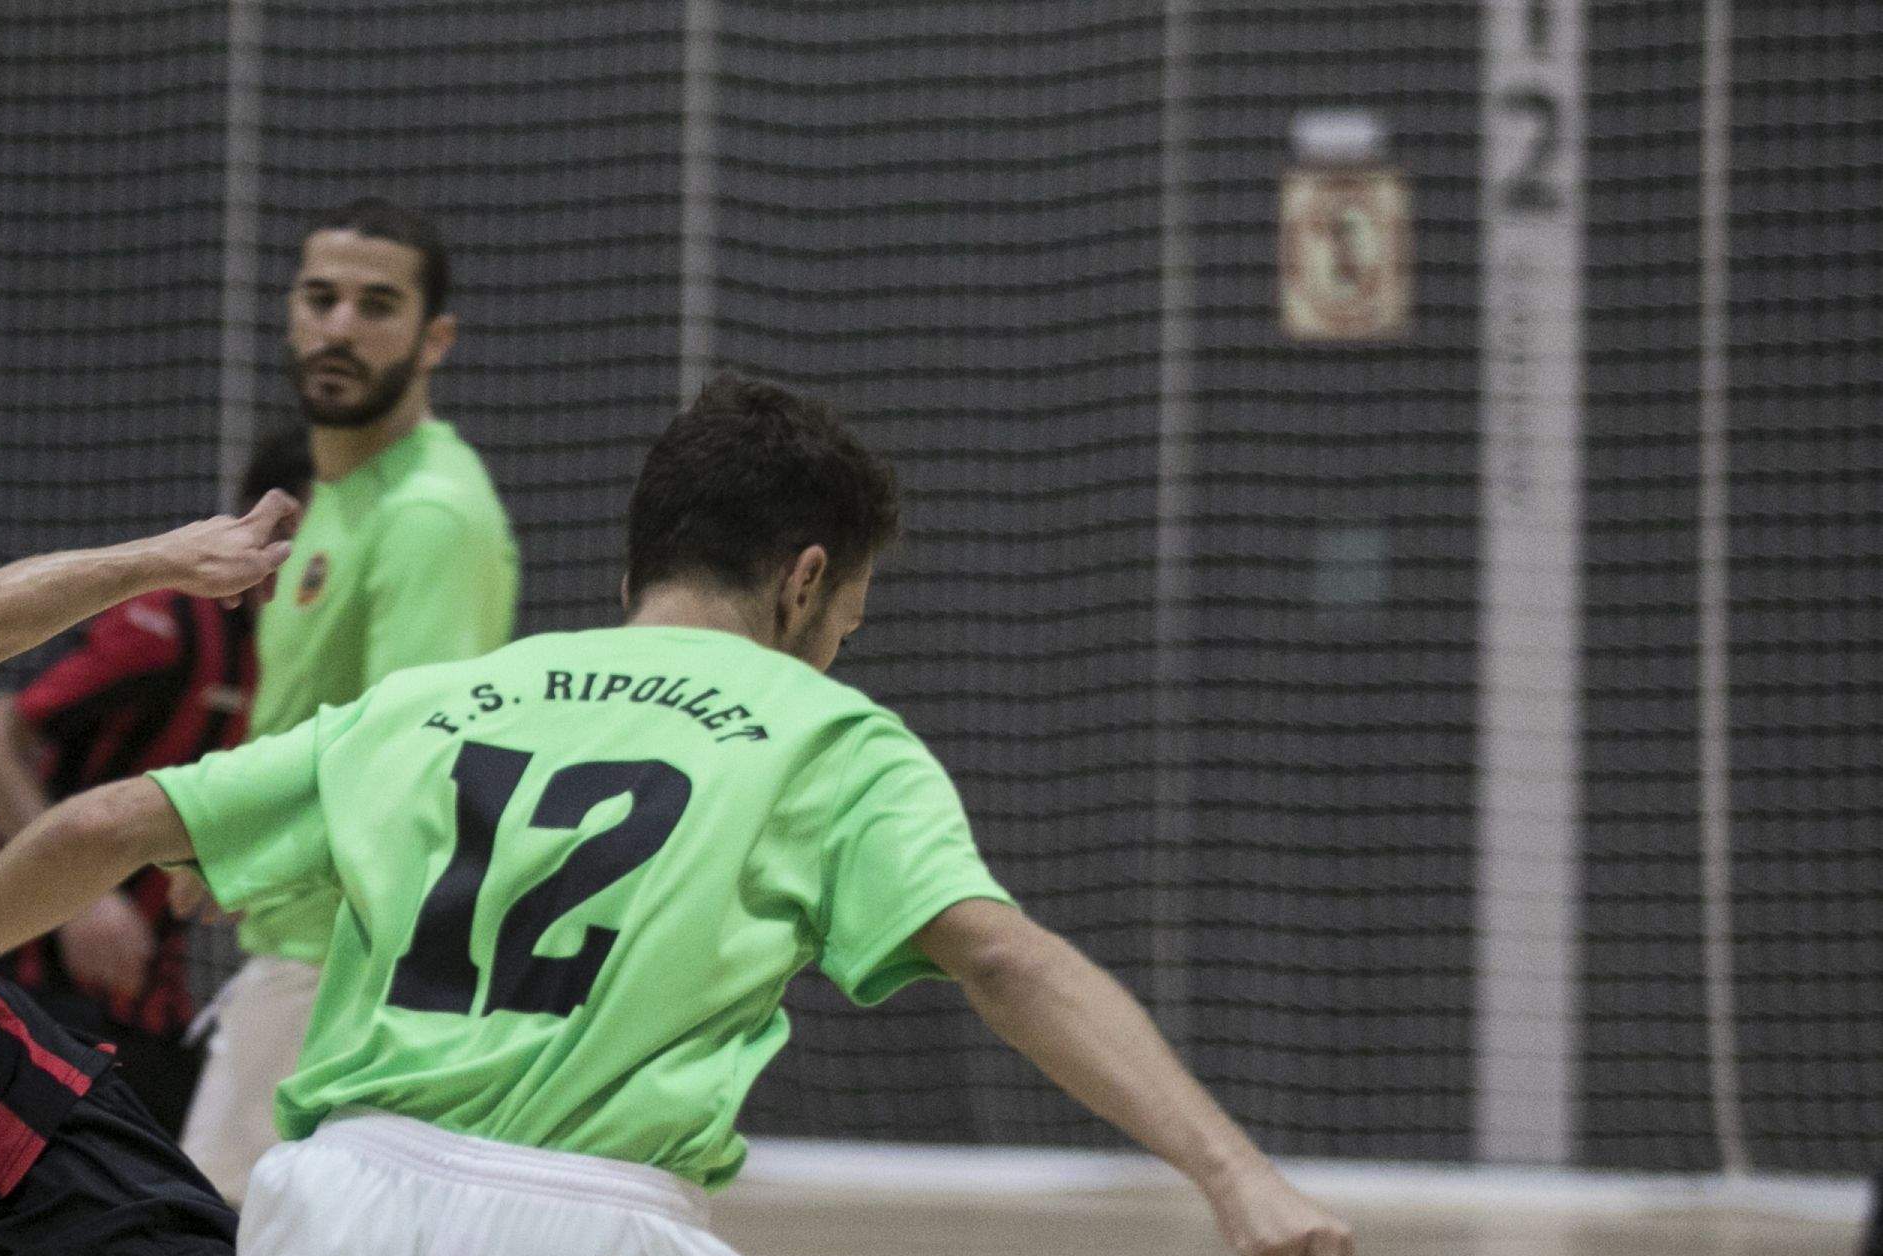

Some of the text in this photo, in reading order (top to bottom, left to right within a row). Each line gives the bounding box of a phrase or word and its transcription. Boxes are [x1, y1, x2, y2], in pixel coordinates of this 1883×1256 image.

[421, 671, 768, 742] F.S. RIPOLLET
[385, 740, 692, 1018] 12
